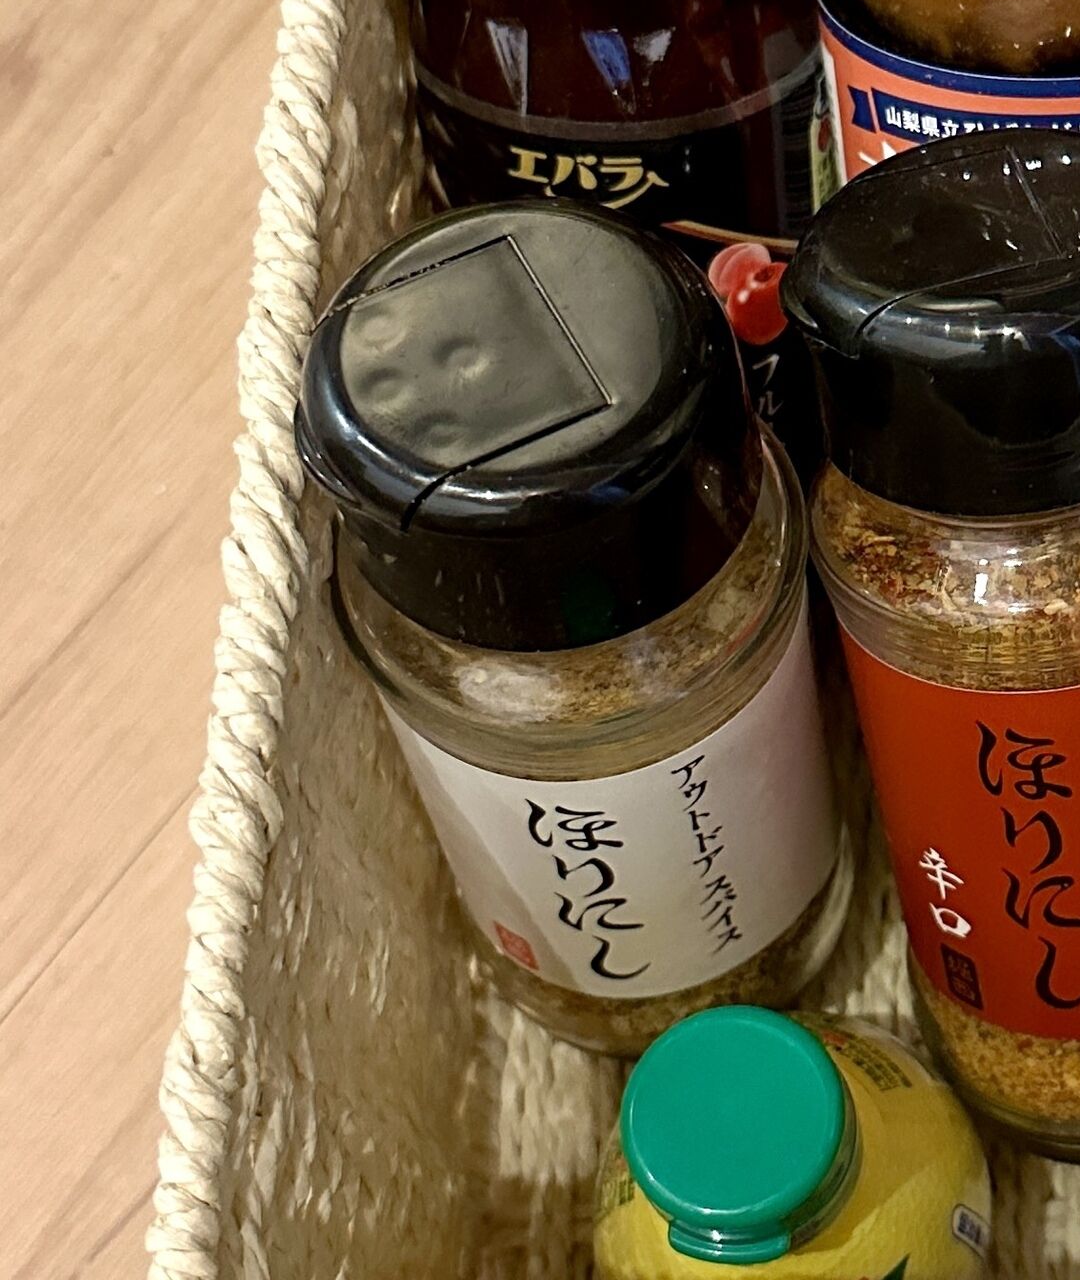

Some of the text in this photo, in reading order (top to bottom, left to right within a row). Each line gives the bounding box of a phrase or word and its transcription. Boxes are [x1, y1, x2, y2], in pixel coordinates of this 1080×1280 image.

[508, 145, 650, 198] エバラ
[524, 798, 651, 980] ほりにし
[918, 846, 973, 939] 辛口
